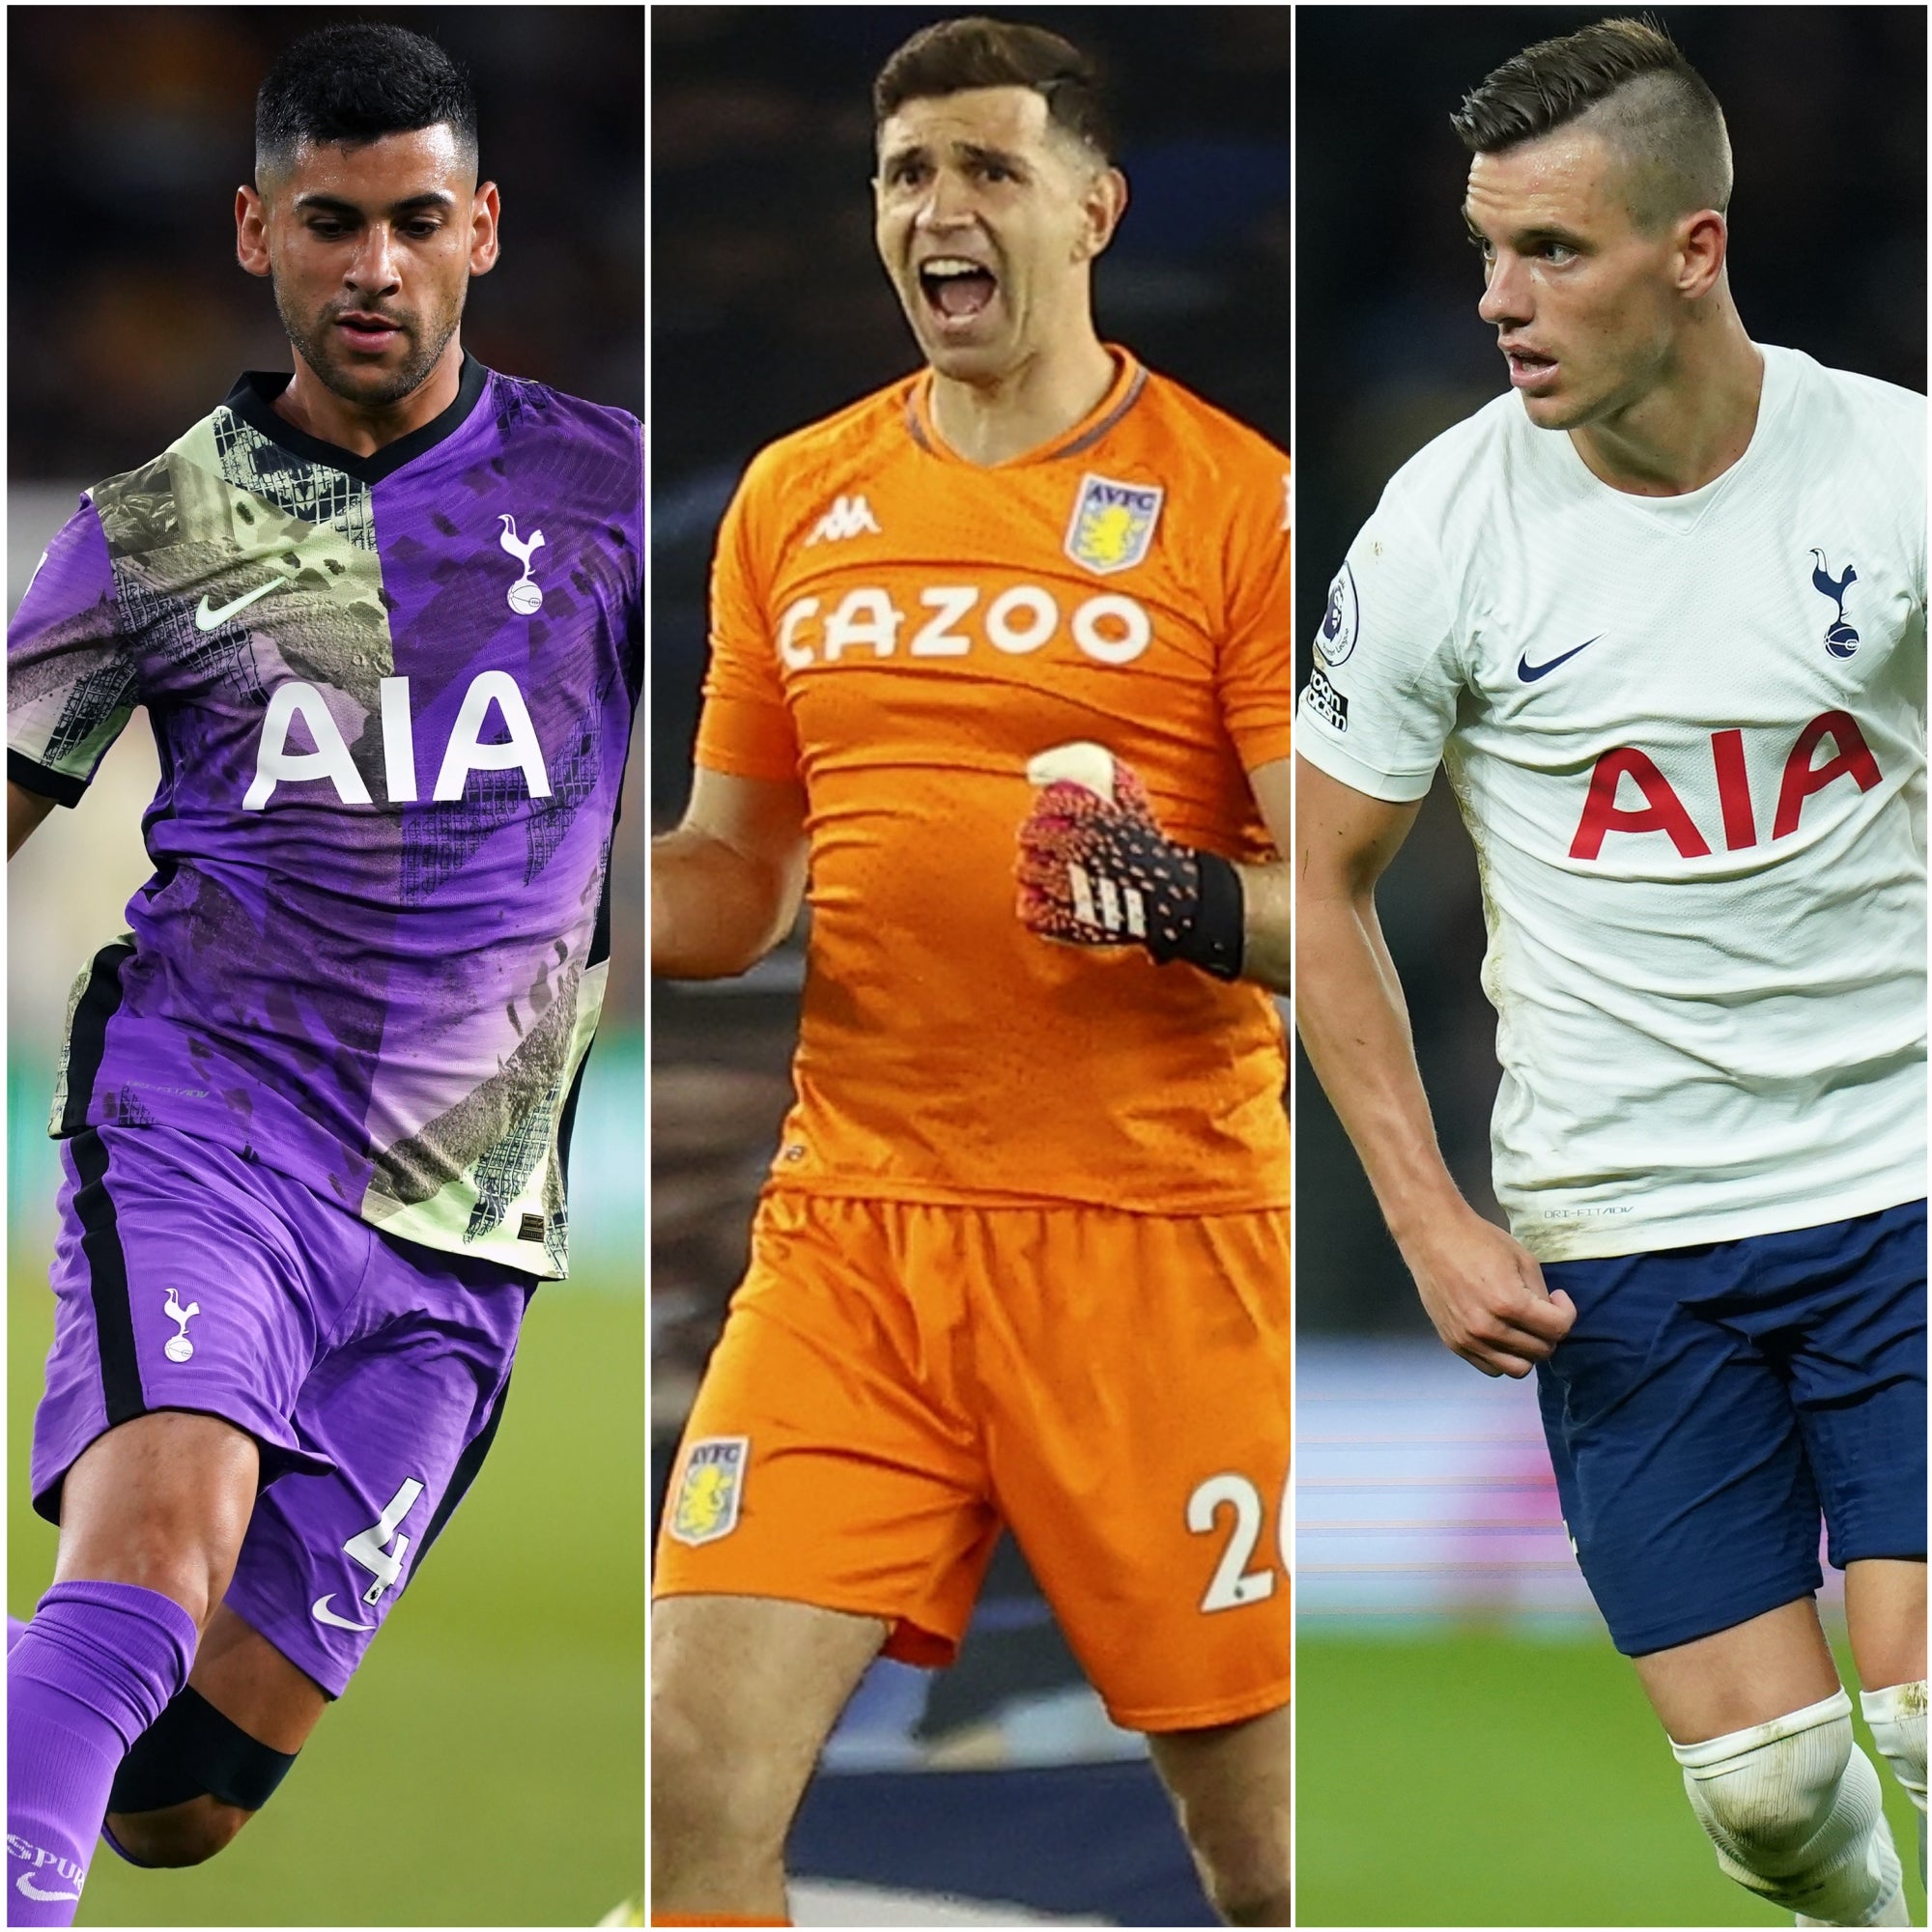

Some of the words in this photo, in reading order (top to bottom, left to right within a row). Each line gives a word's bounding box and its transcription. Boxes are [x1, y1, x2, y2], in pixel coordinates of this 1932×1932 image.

[1087, 484, 1156, 510] AVFC
[780, 585, 1151, 671] CAZOO
[242, 670, 552, 810] AIA
[1307, 689, 1347, 732] acism
[1569, 709, 1883, 860] AIA
[343, 1476, 425, 1606] 4
